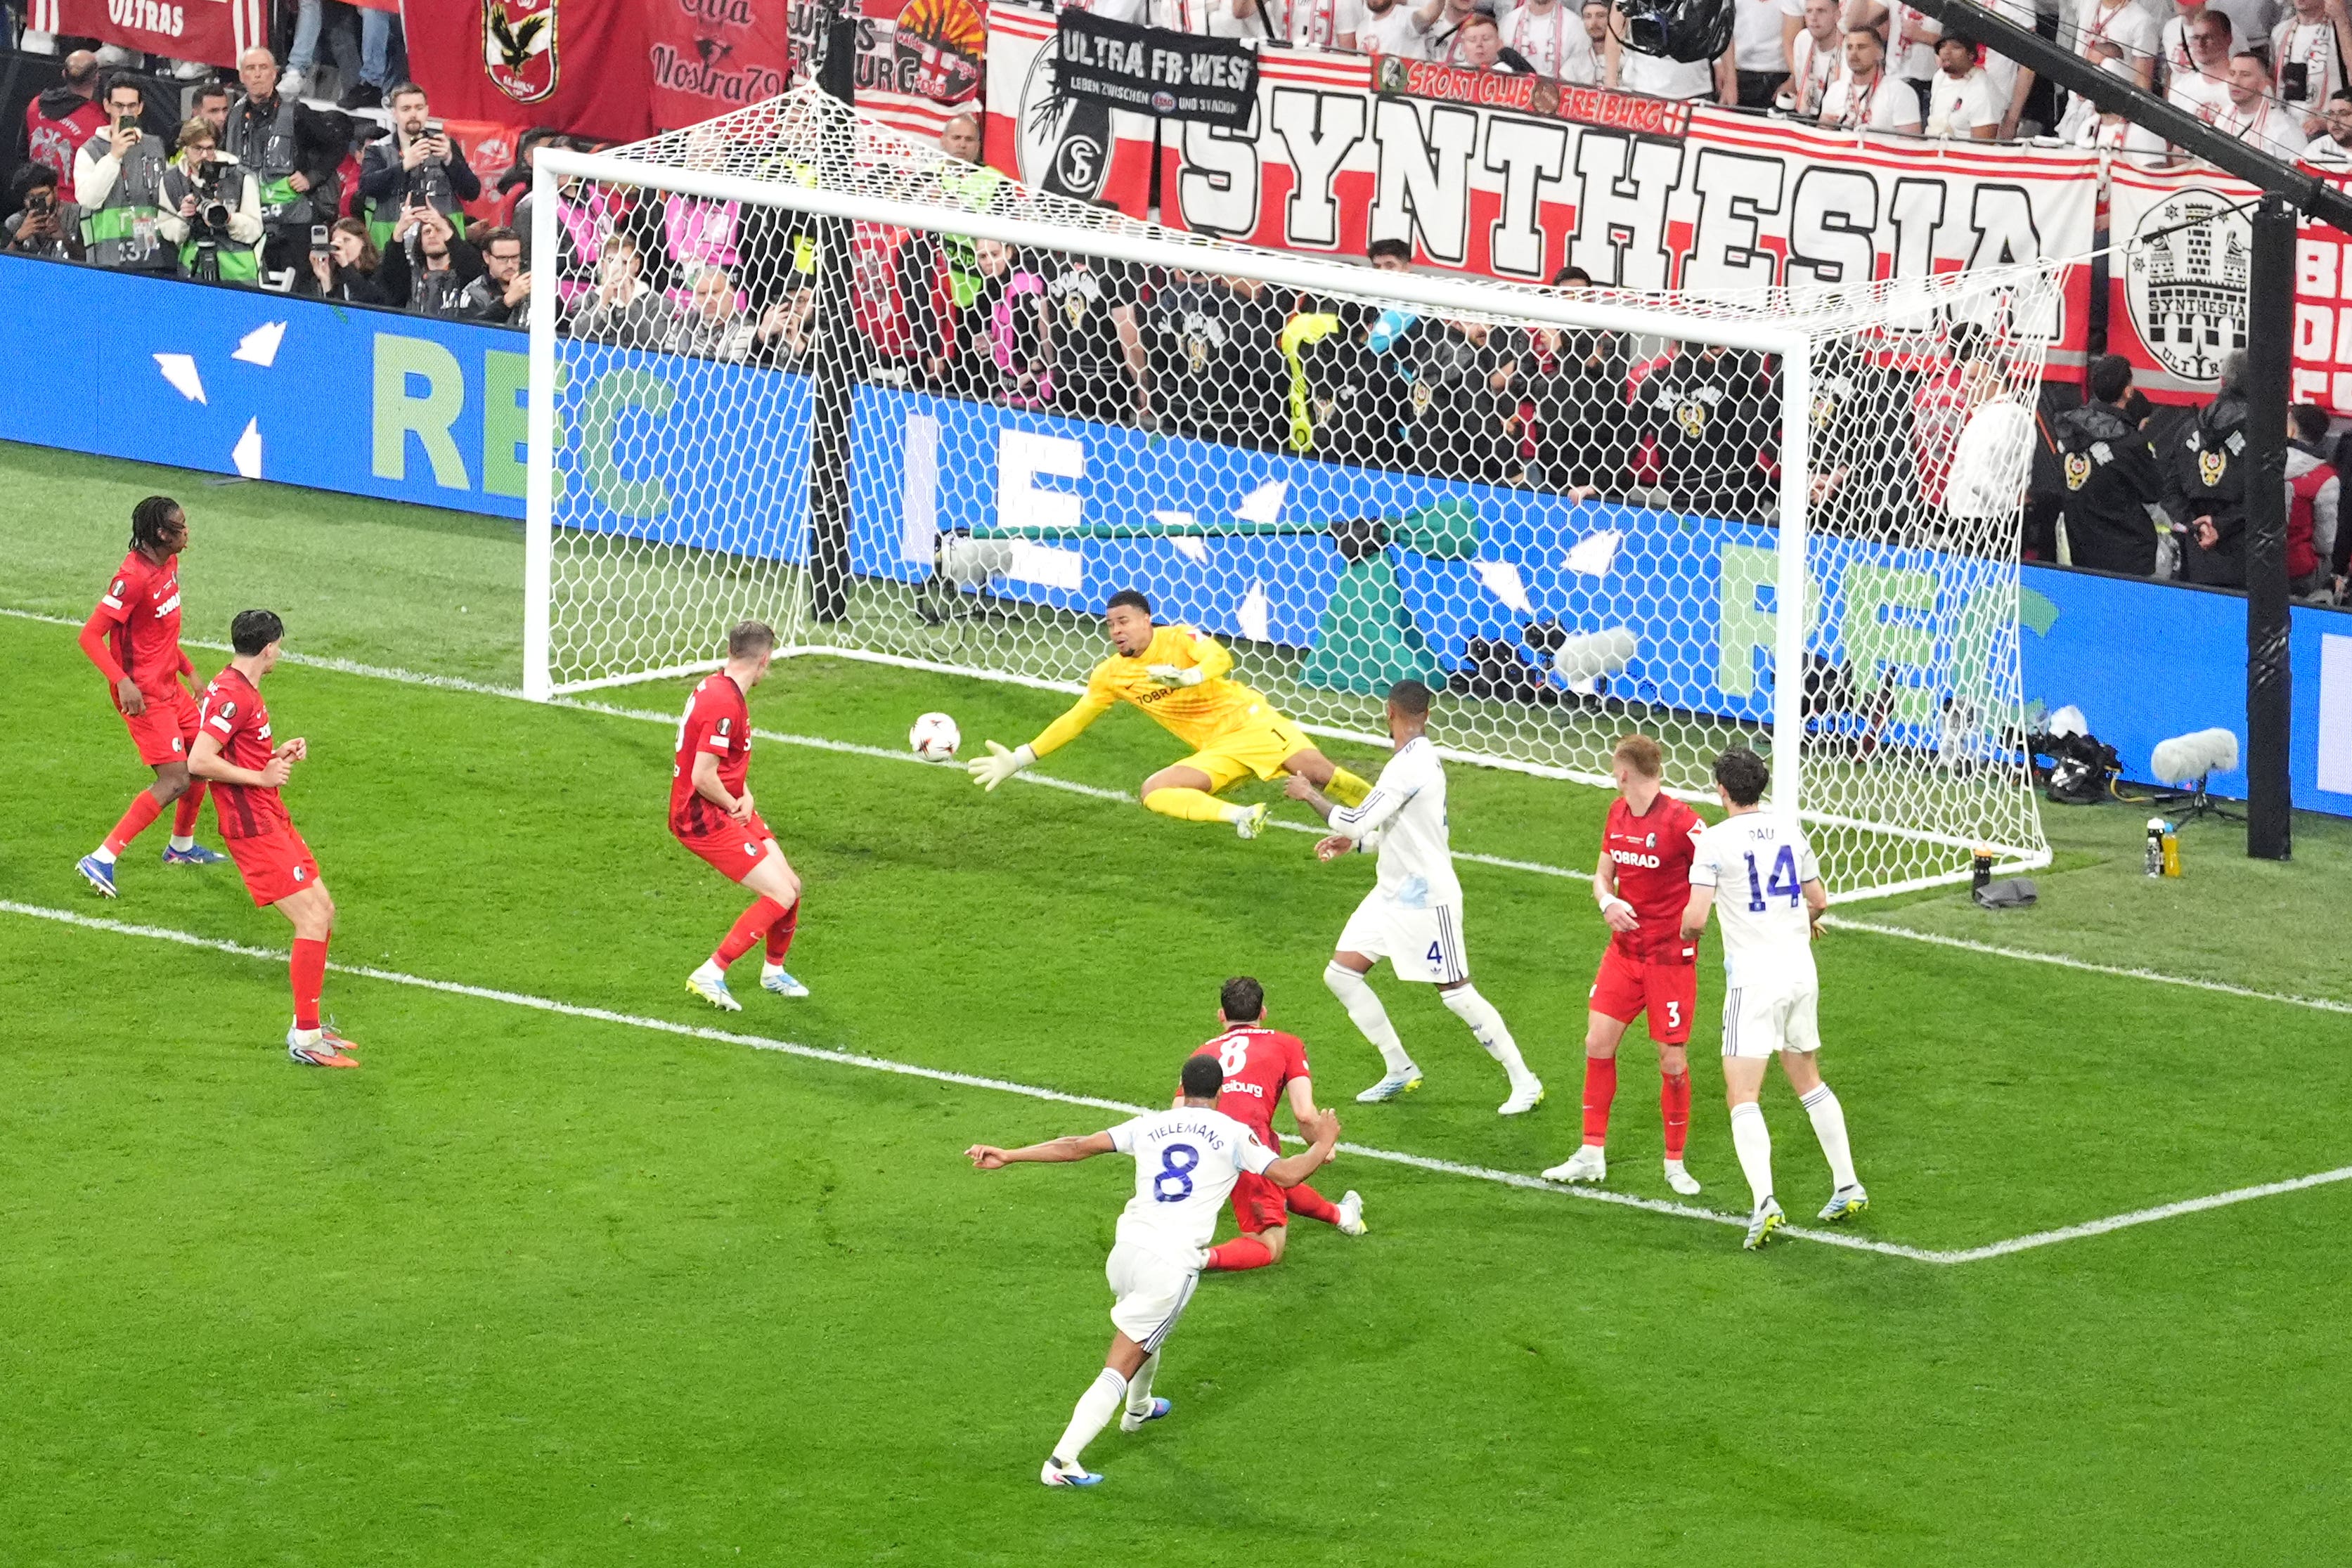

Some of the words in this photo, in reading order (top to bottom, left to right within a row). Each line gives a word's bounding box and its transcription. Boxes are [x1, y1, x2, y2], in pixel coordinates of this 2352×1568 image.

[1063, 27, 1145, 79] ULTRA
[1070, 75, 1100, 95] LEBEN
[1101, 81, 1149, 105] ZWISCHEN
[1178, 96, 1198, 110] UND
[1407, 60, 1479, 102] SPORT
[1478, 72, 1534, 112] CLUB
[1556, 85, 1664, 134] FREIBURG
[1180, 89, 2062, 343] SYNTHESIA
[2149, 299, 2246, 317] SYNTHESIA
[1271, 728, 1286, 741] 1
[1748, 828, 1775, 841] PAU
[1743, 845, 1801, 912] 14
[1427, 941, 1442, 964] 4
[1667, 1001, 1681, 1028] 3
[1218, 1030, 1250, 1077] 8
[1221, 1080, 1263, 1098] eiburg
[1147, 1123, 1225, 1151] TIELEMANS
[1154, 1143, 1199, 1203] 8
